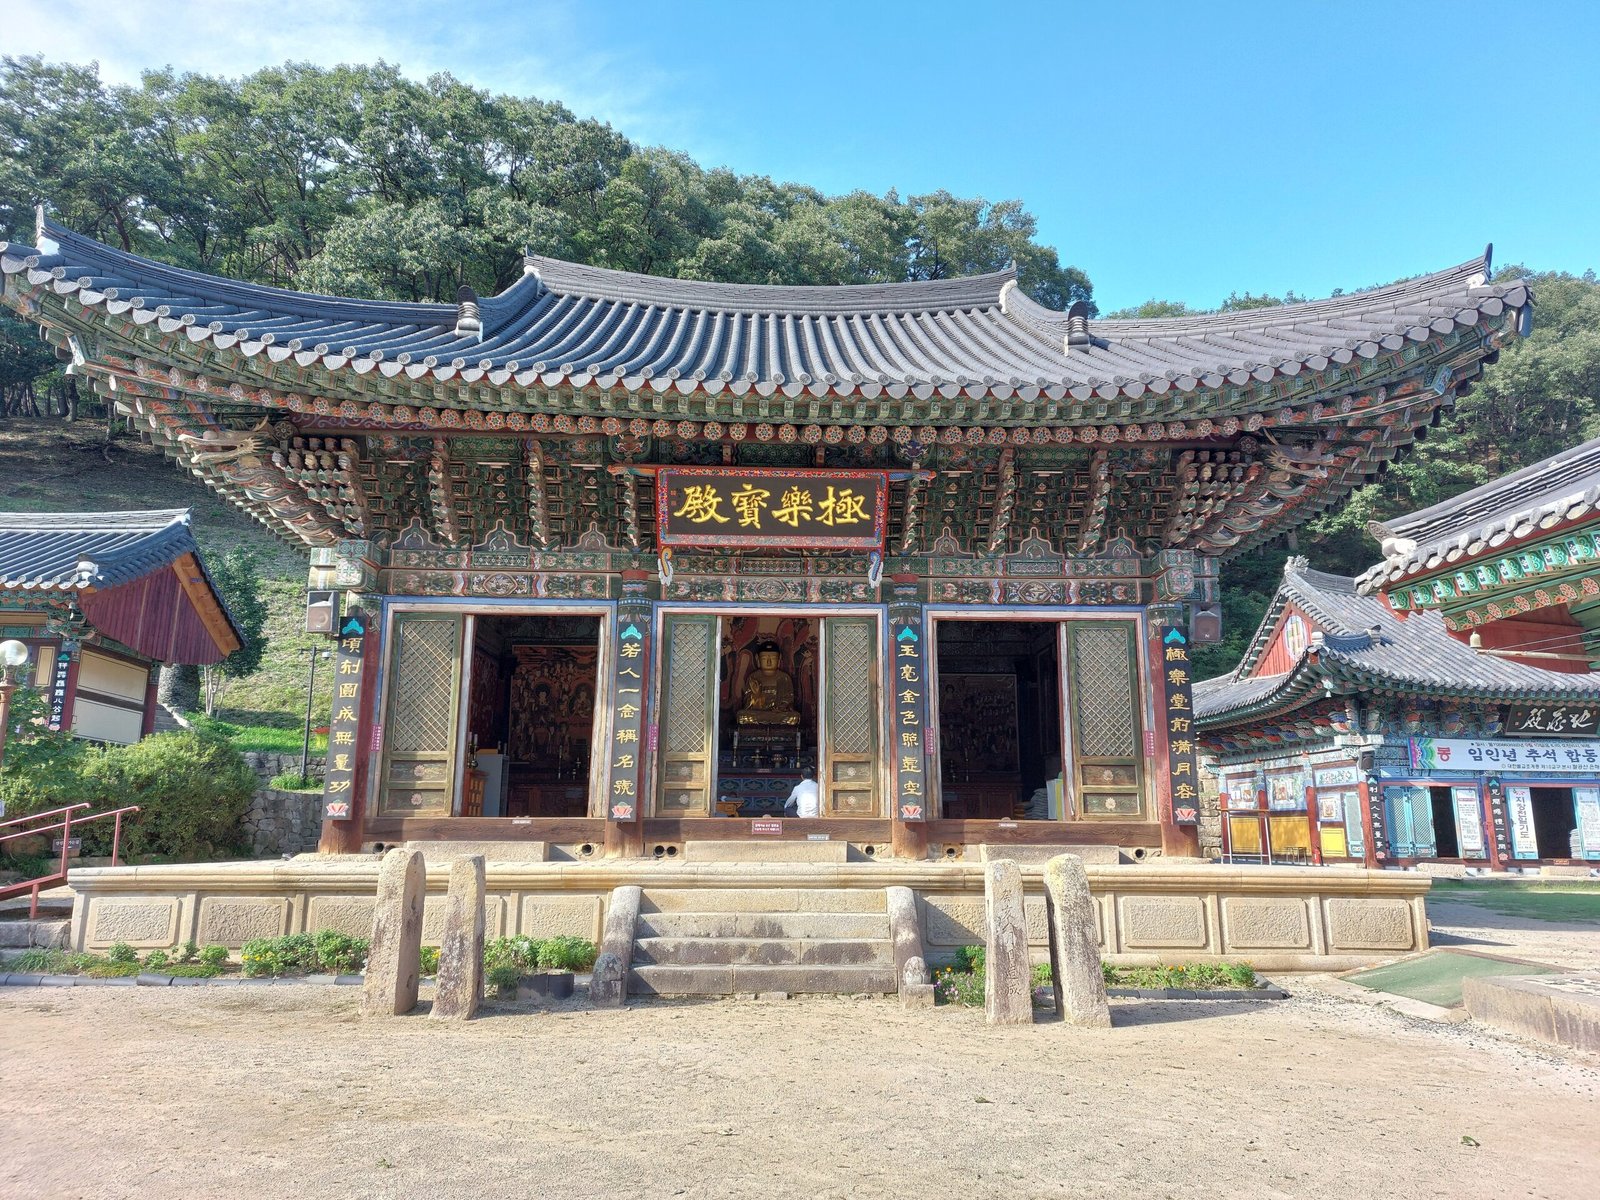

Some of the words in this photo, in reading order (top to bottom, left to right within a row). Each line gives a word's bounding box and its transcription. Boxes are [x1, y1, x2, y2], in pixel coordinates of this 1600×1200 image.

[1468, 747, 1517, 761] 임인년
[1525, 749, 1557, 762] 추석
[1564, 749, 1598, 763] 합동
